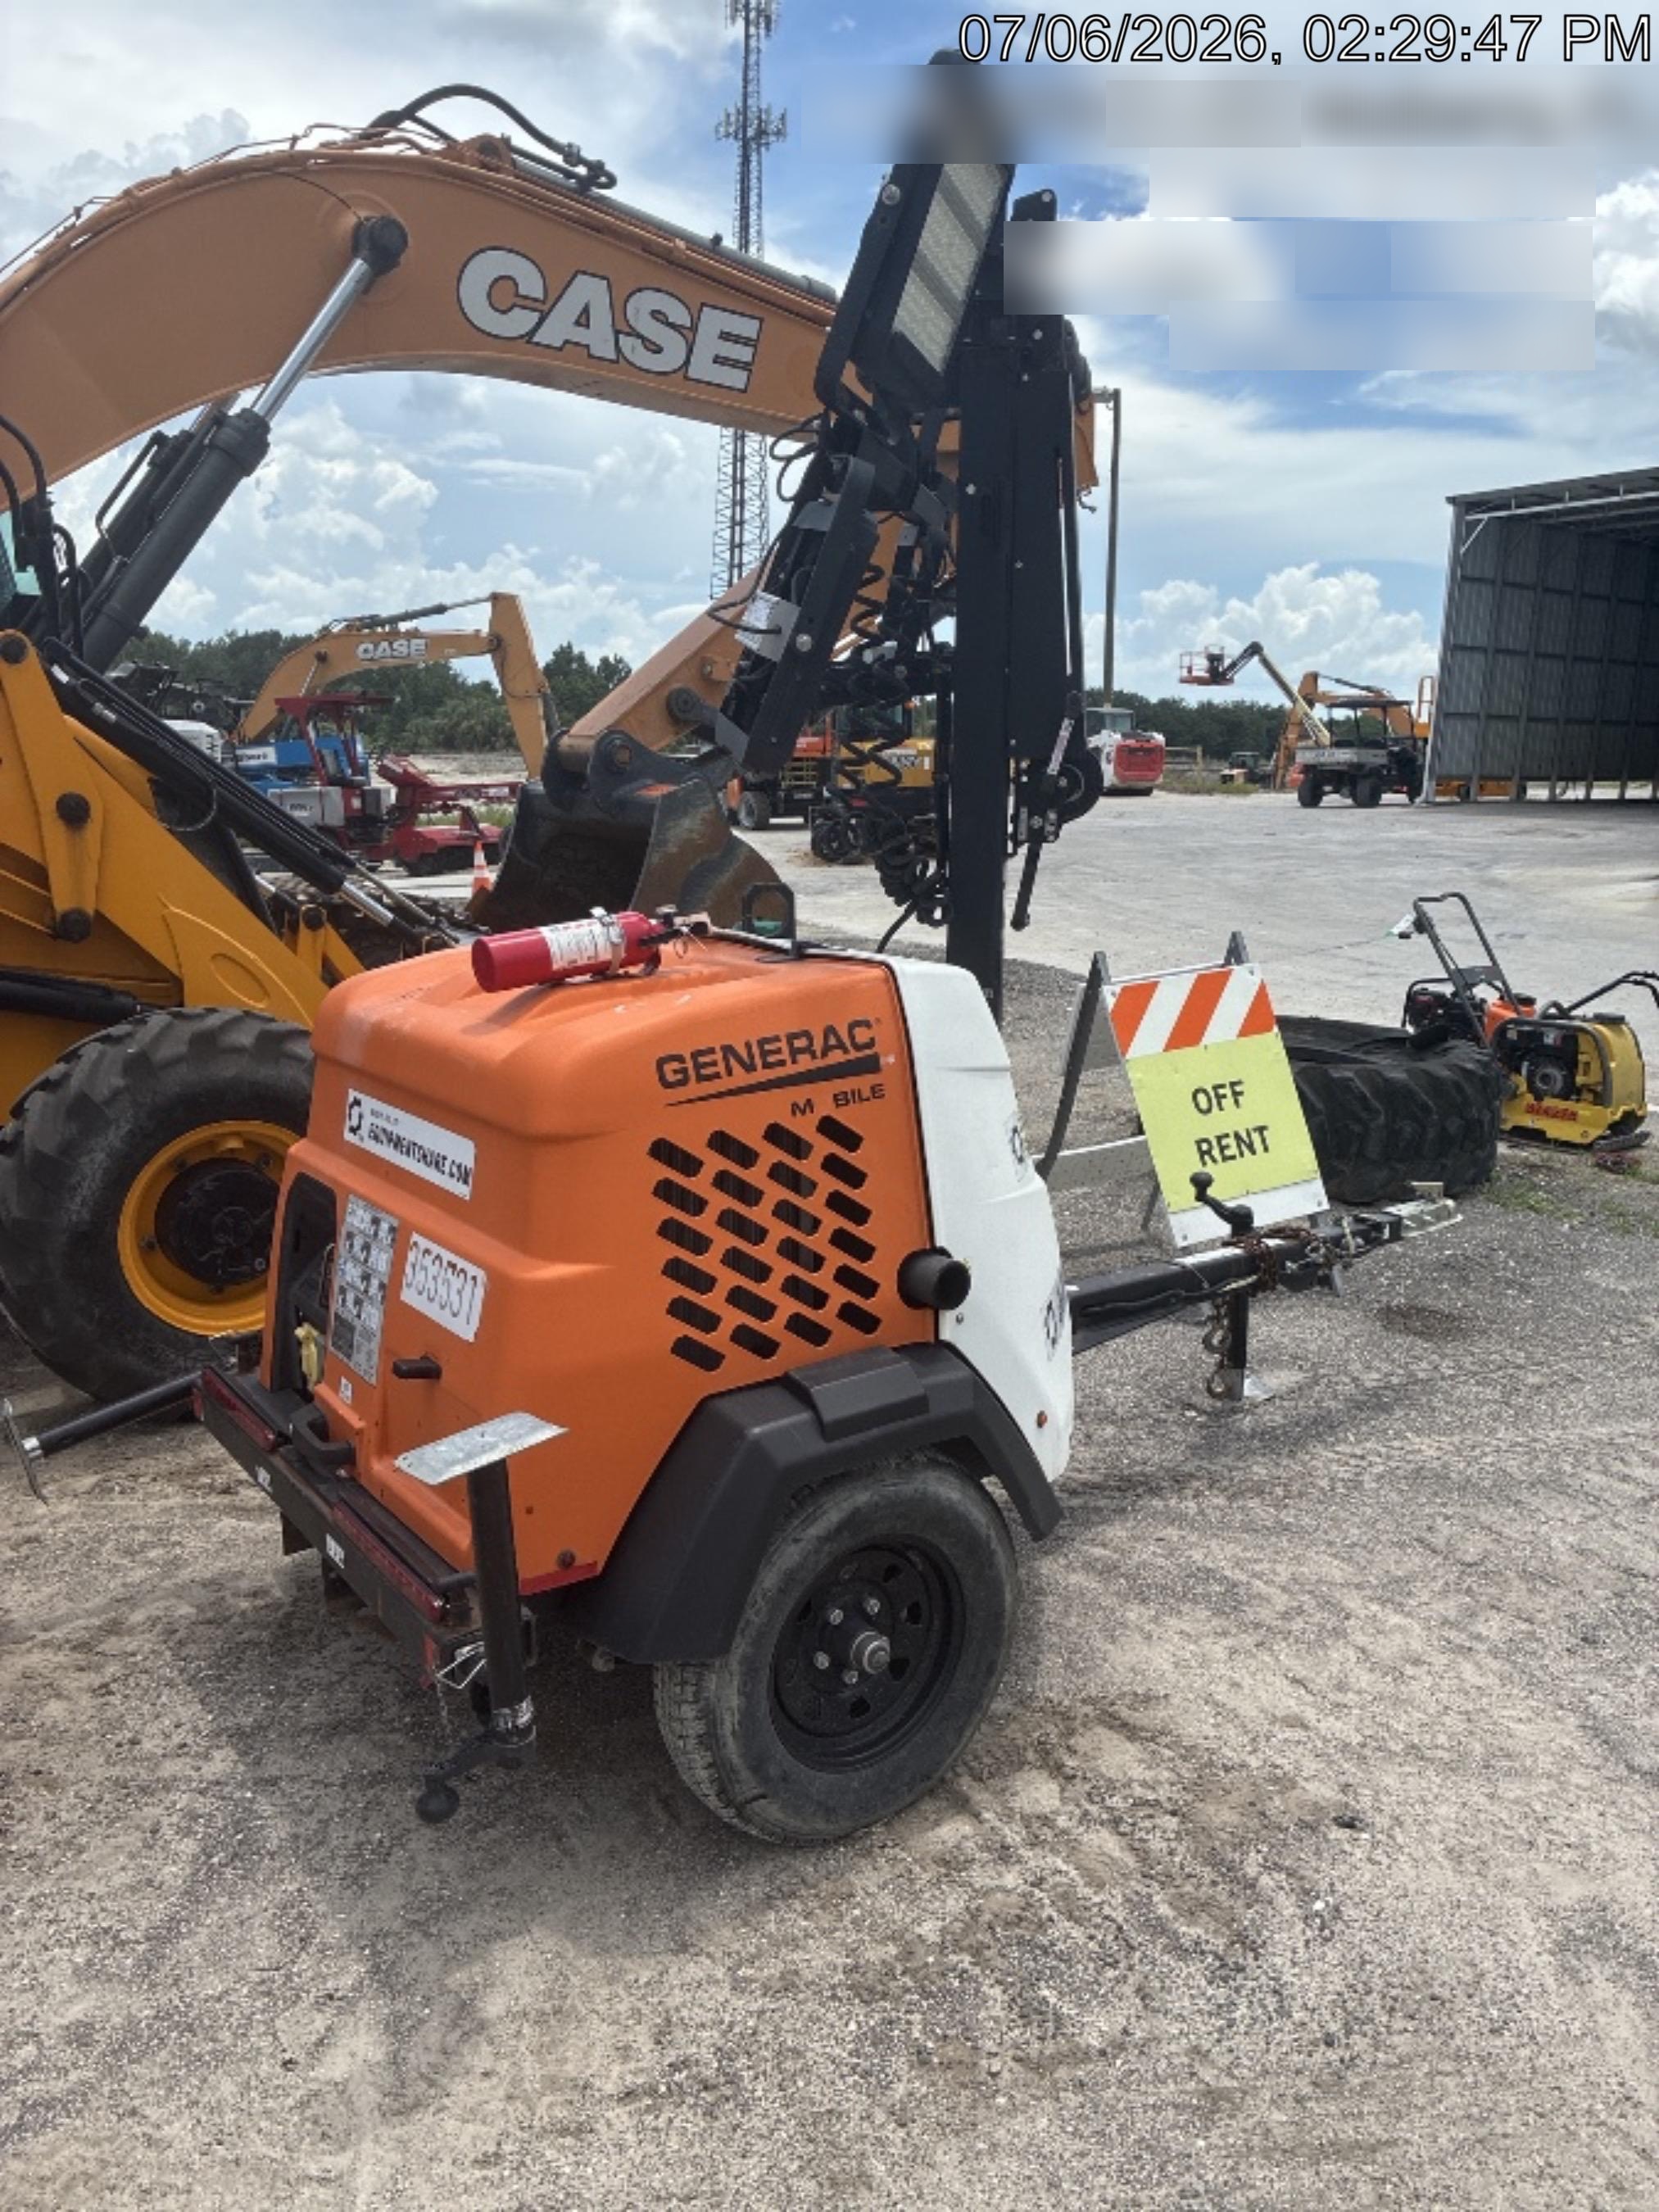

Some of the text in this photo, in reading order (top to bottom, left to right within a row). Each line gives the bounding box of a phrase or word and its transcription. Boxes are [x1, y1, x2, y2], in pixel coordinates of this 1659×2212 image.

[456, 246, 764, 393] CASE
[357, 638, 428, 660] CASE
[656, 1018, 877, 1090] GENERAC
[1192, 1079, 1244, 1116] OFF
[1194, 1124, 1269, 1167] RENT
